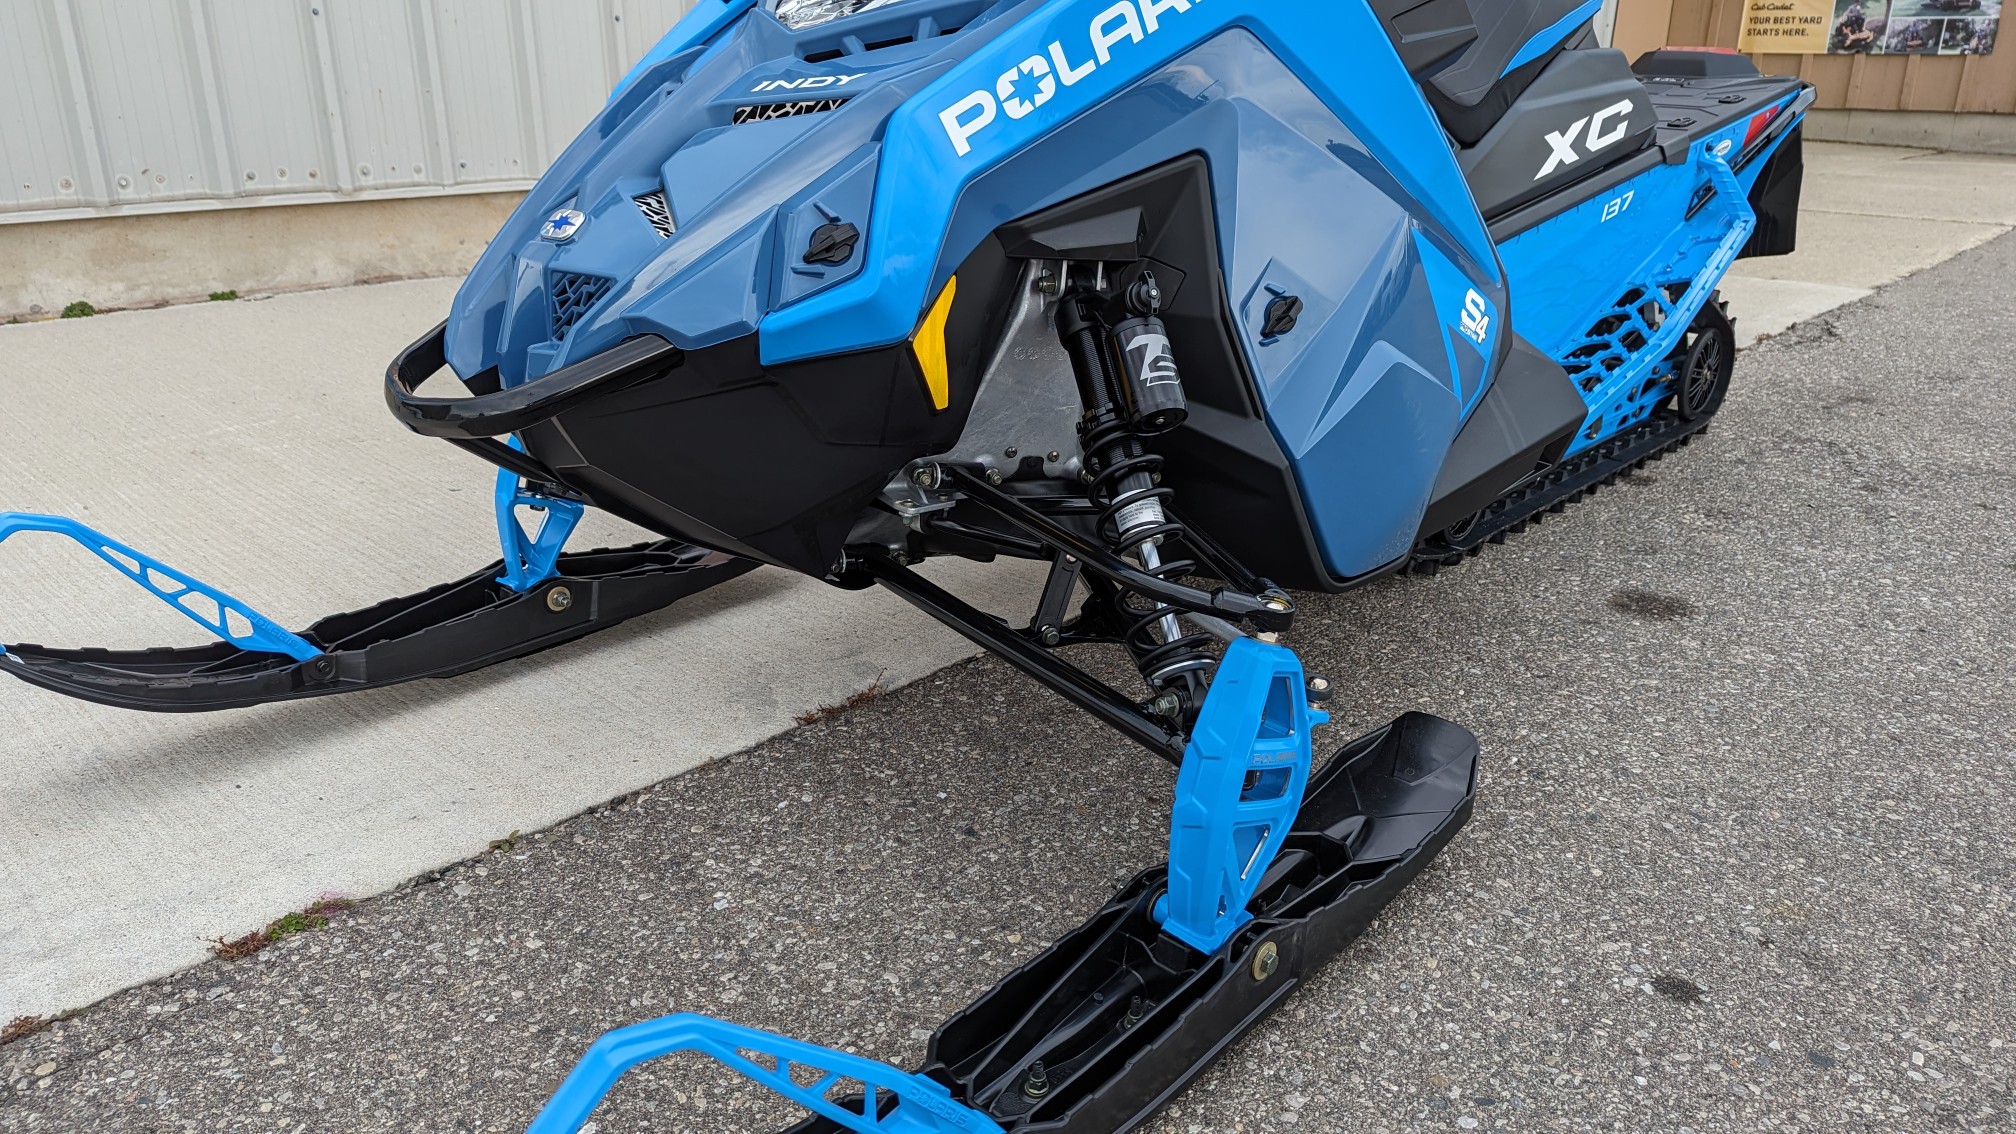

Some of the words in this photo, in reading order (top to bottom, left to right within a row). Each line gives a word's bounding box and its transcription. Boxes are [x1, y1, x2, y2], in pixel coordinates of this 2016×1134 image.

[1749, 16, 1771, 25] YOUR
[1773, 16, 1796, 25] BEST
[1798, 16, 1823, 25] YARD
[1751, 3, 1766, 11] Cub
[1766, 3, 1795, 11] Cadet
[1747, 28, 1780, 37] STARTS
[1782, 28, 1809, 37] HERE.
[751, 73, 868, 92] INDY
[938, 0, 1201, 158] POLAR
[1533, 98, 1634, 181] XC
[1601, 189, 1635, 223] 137
[1461, 288, 1490, 344] S4
[908, 1085, 969, 1127] POLARIS
